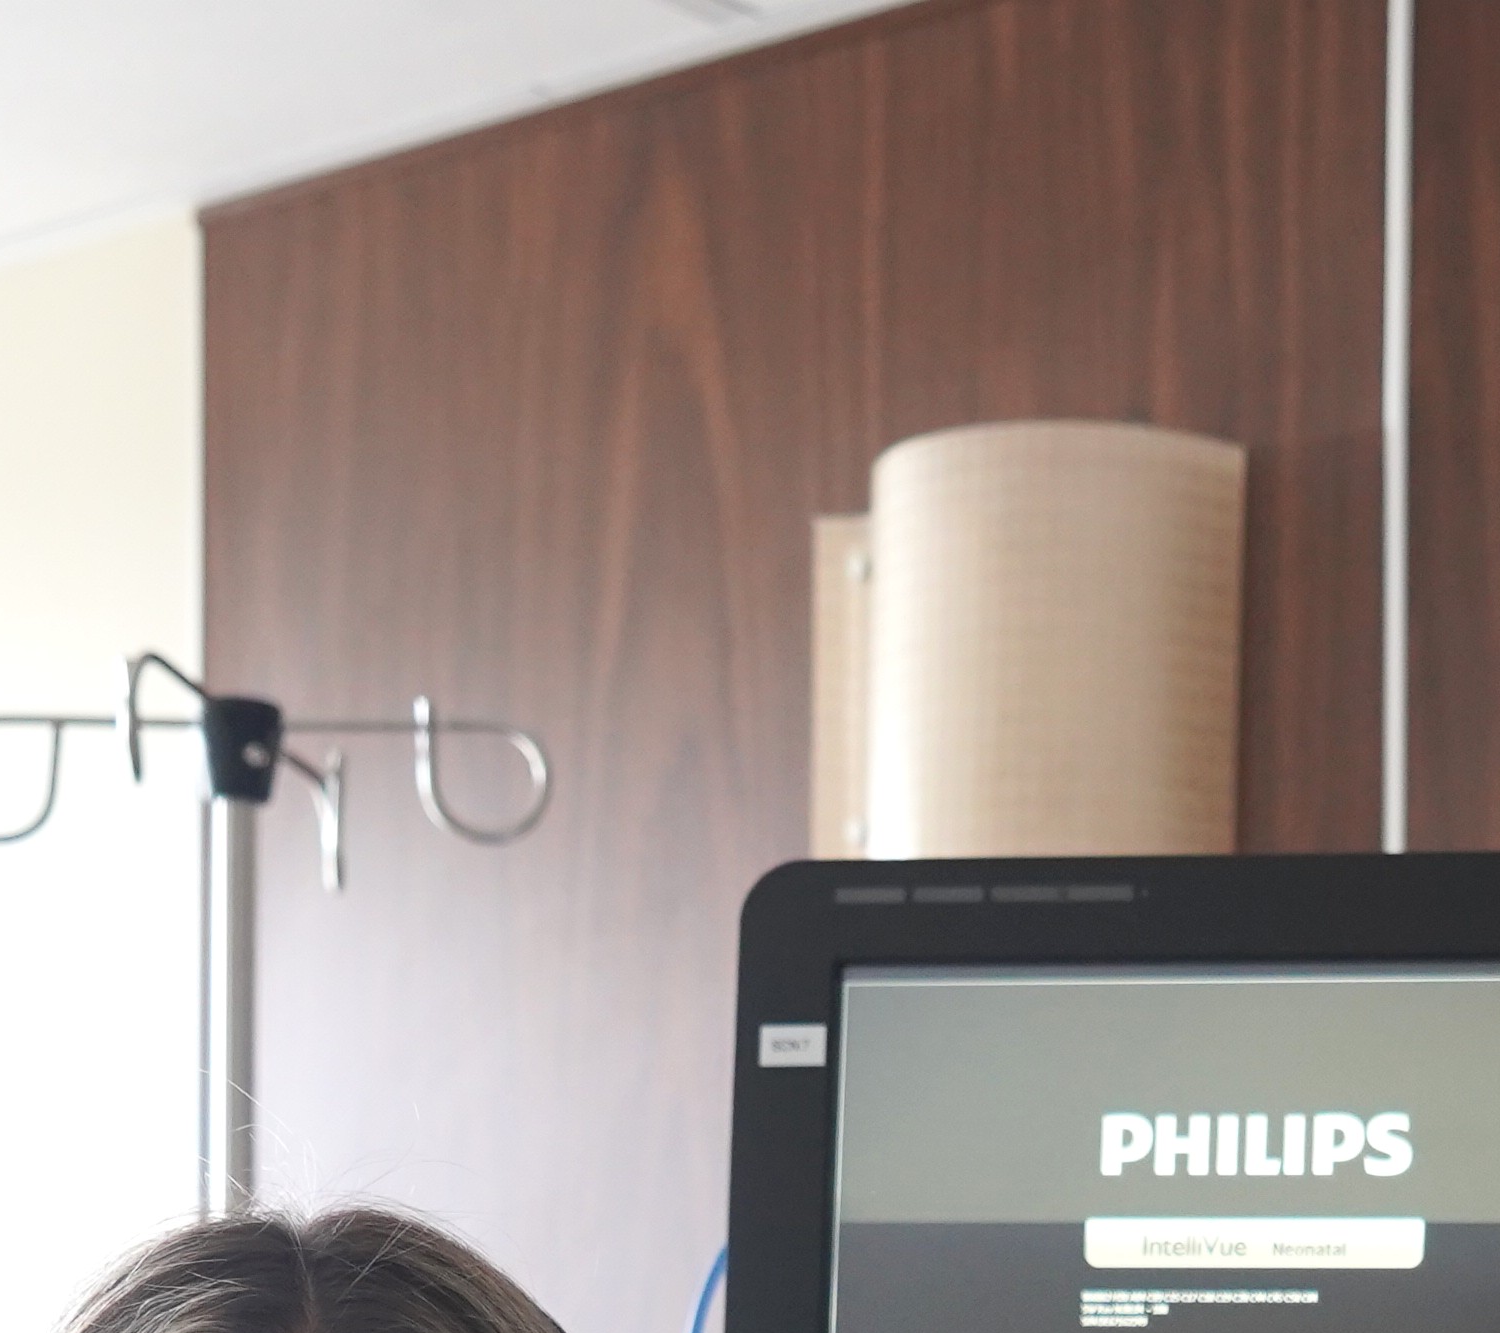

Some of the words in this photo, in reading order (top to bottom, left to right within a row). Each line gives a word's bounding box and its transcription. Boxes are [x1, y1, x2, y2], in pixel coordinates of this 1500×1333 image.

[1100, 1112, 1413, 1177] PHILIPS
[1141, 1236, 1247, 1257] IntelliVue
[1272, 1241, 1347, 1257] Neonatal
